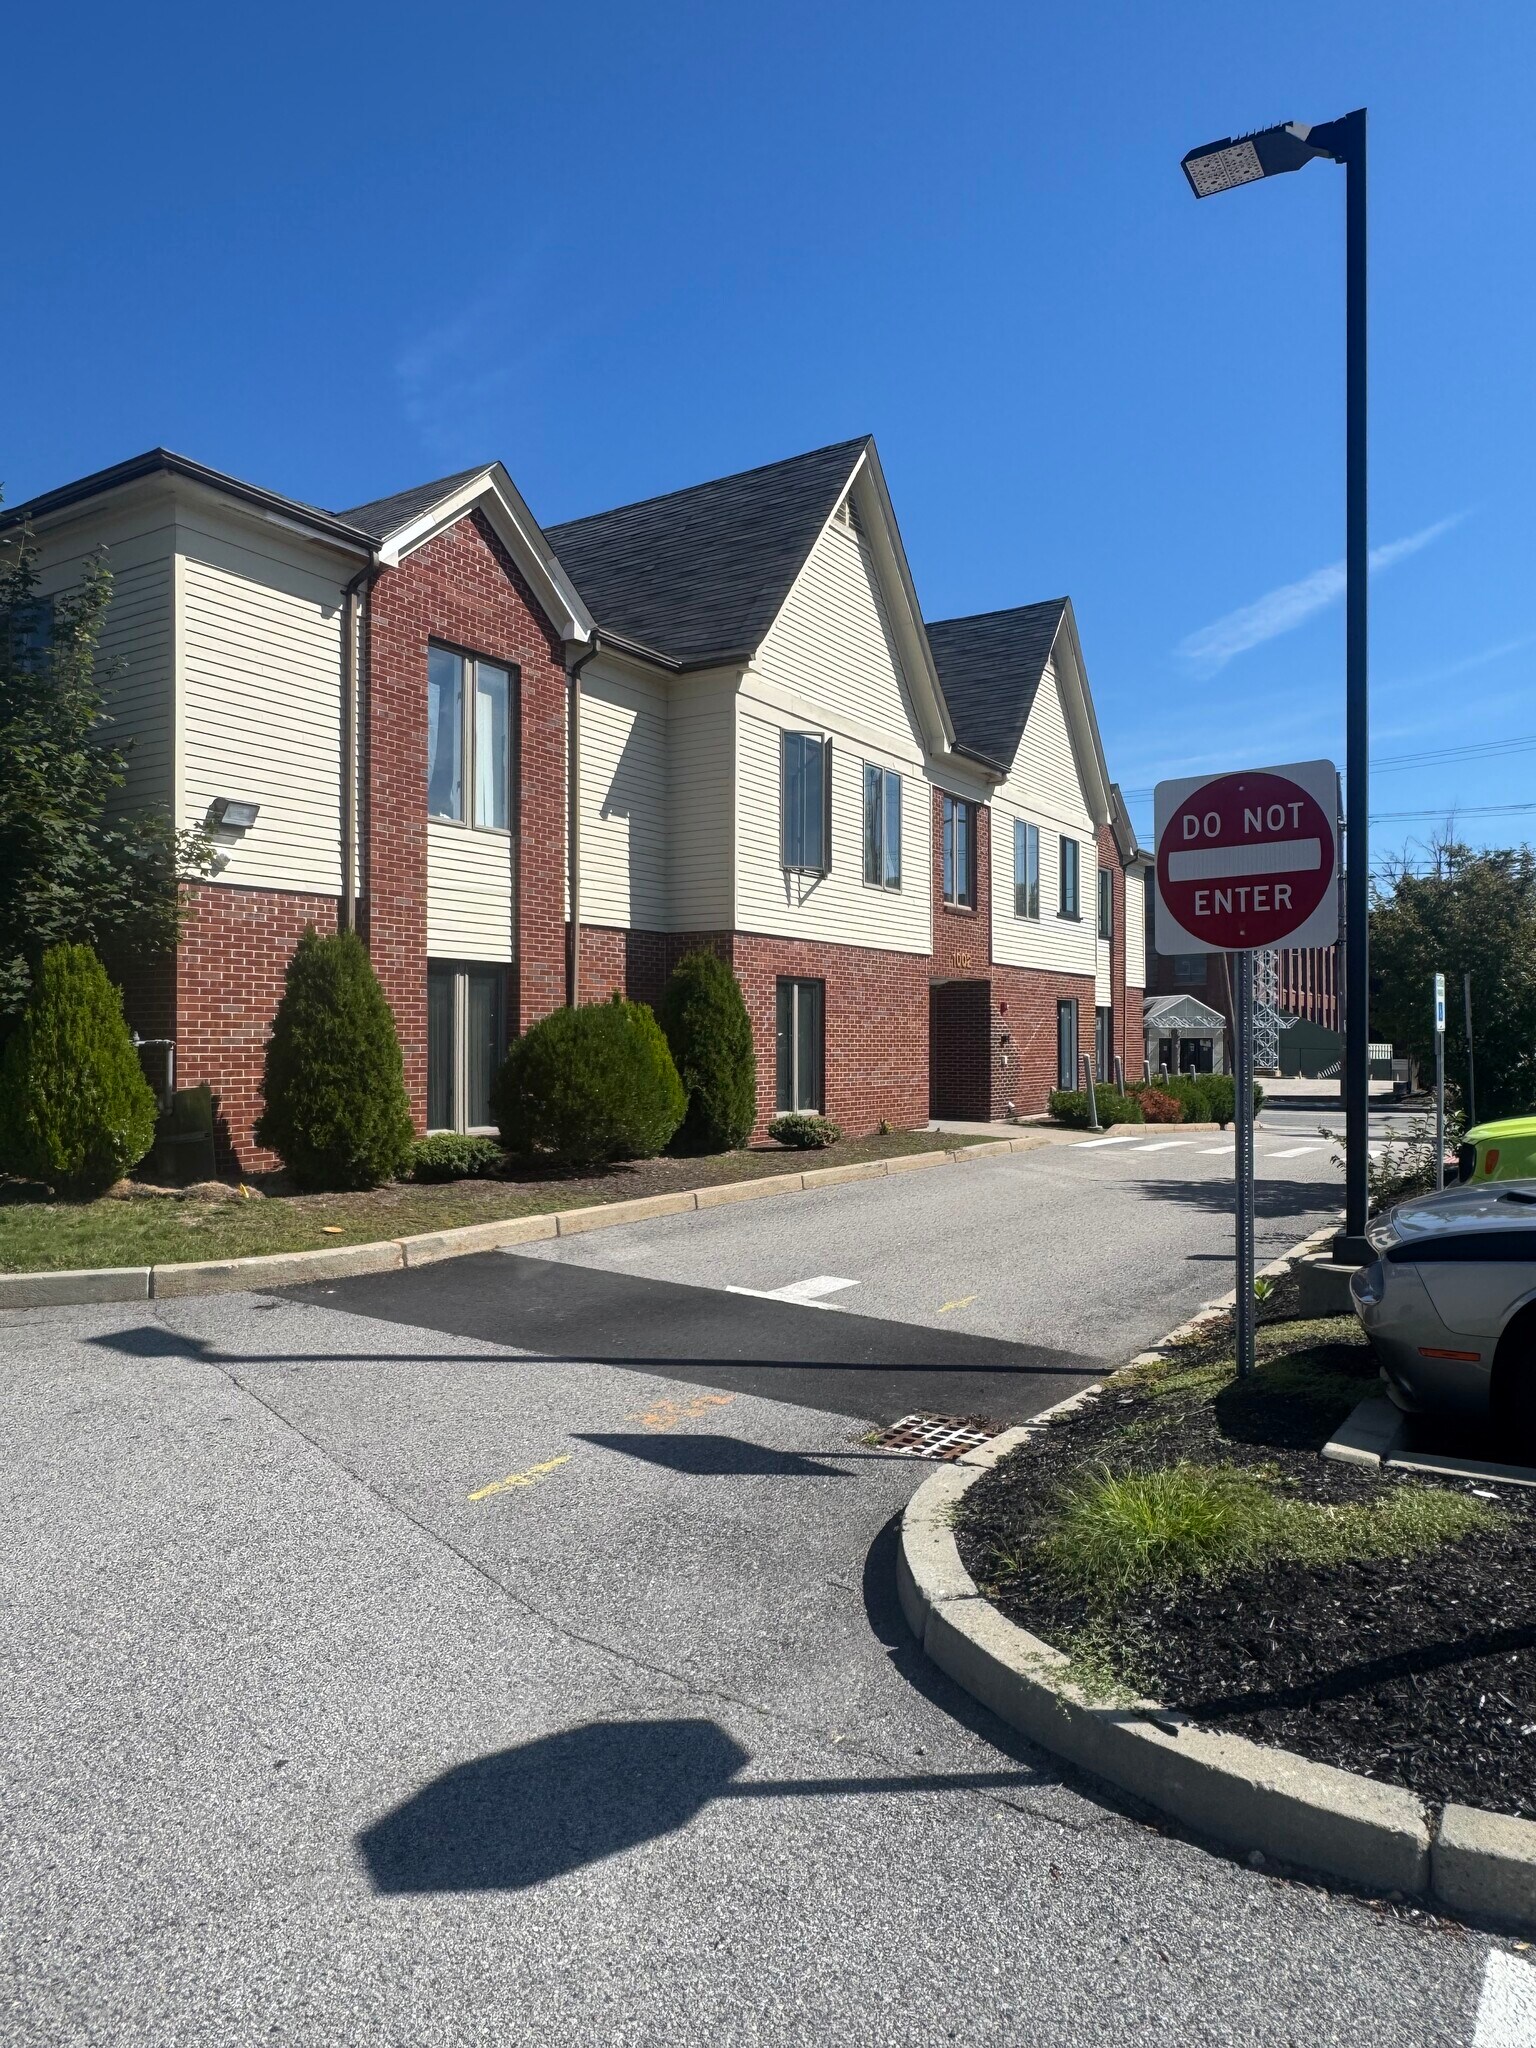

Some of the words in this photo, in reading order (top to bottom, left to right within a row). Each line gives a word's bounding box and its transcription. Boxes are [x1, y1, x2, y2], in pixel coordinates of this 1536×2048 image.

[1183, 811, 1221, 840] DO
[1244, 802, 1304, 834] NOT
[1195, 884, 1293, 916] ENTER
[952, 952, 972, 969] 1002
